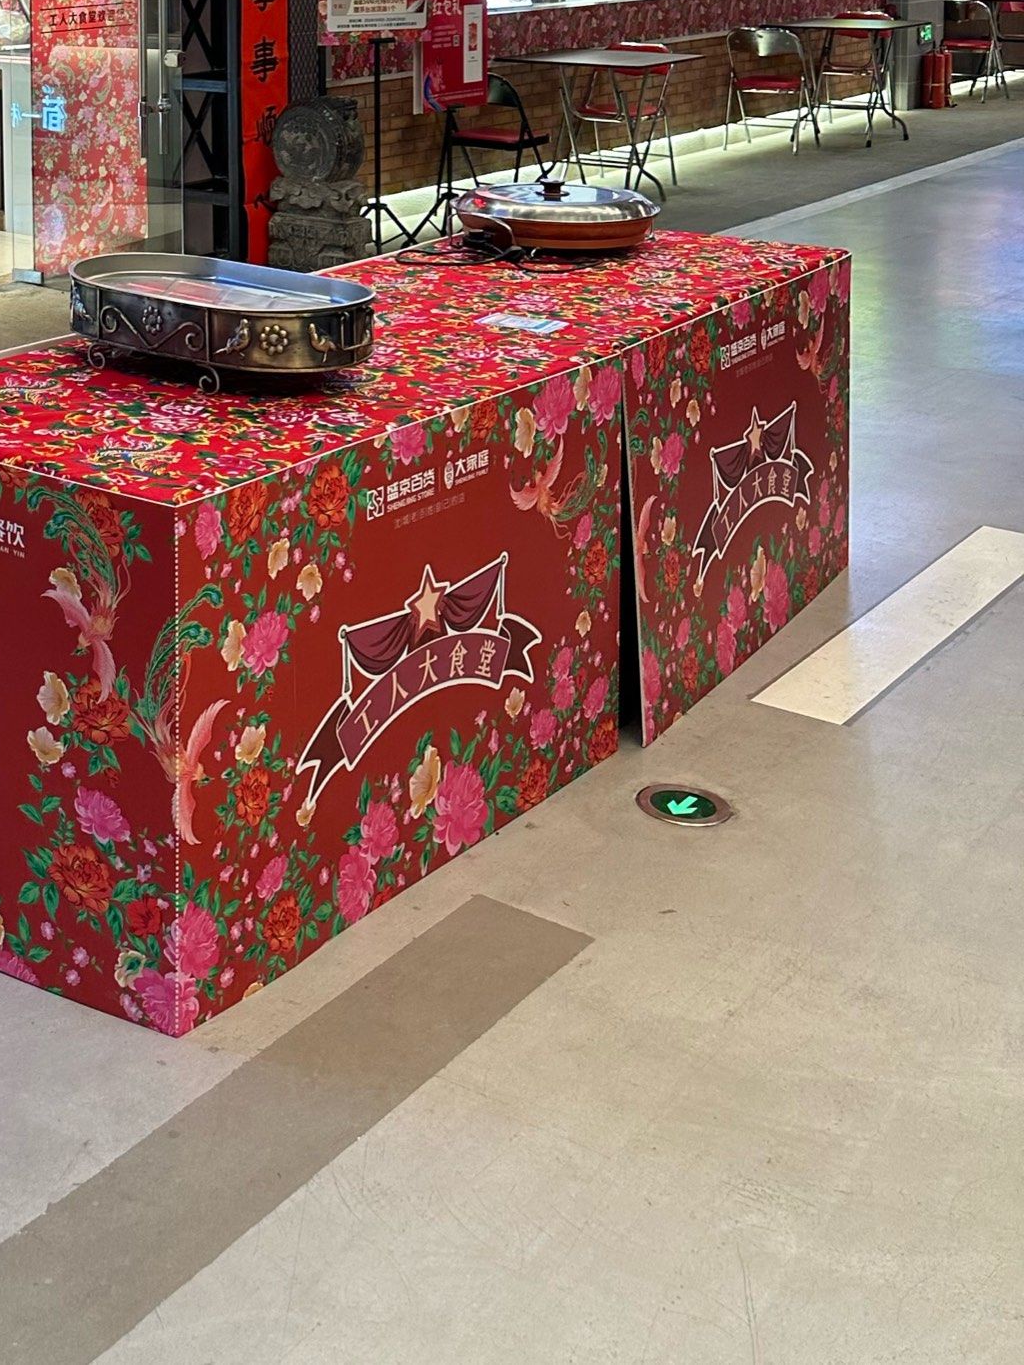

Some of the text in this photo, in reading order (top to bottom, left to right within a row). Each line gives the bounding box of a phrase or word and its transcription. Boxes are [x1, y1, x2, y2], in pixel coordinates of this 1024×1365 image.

[455, 449, 489, 477] 大家庭
[387, 468, 435, 502] 盛京百货
[720, 466, 793, 541] 工人大食堂
[13, 549, 25, 559] YIN
[354, 639, 497, 746] 工人大食堂
